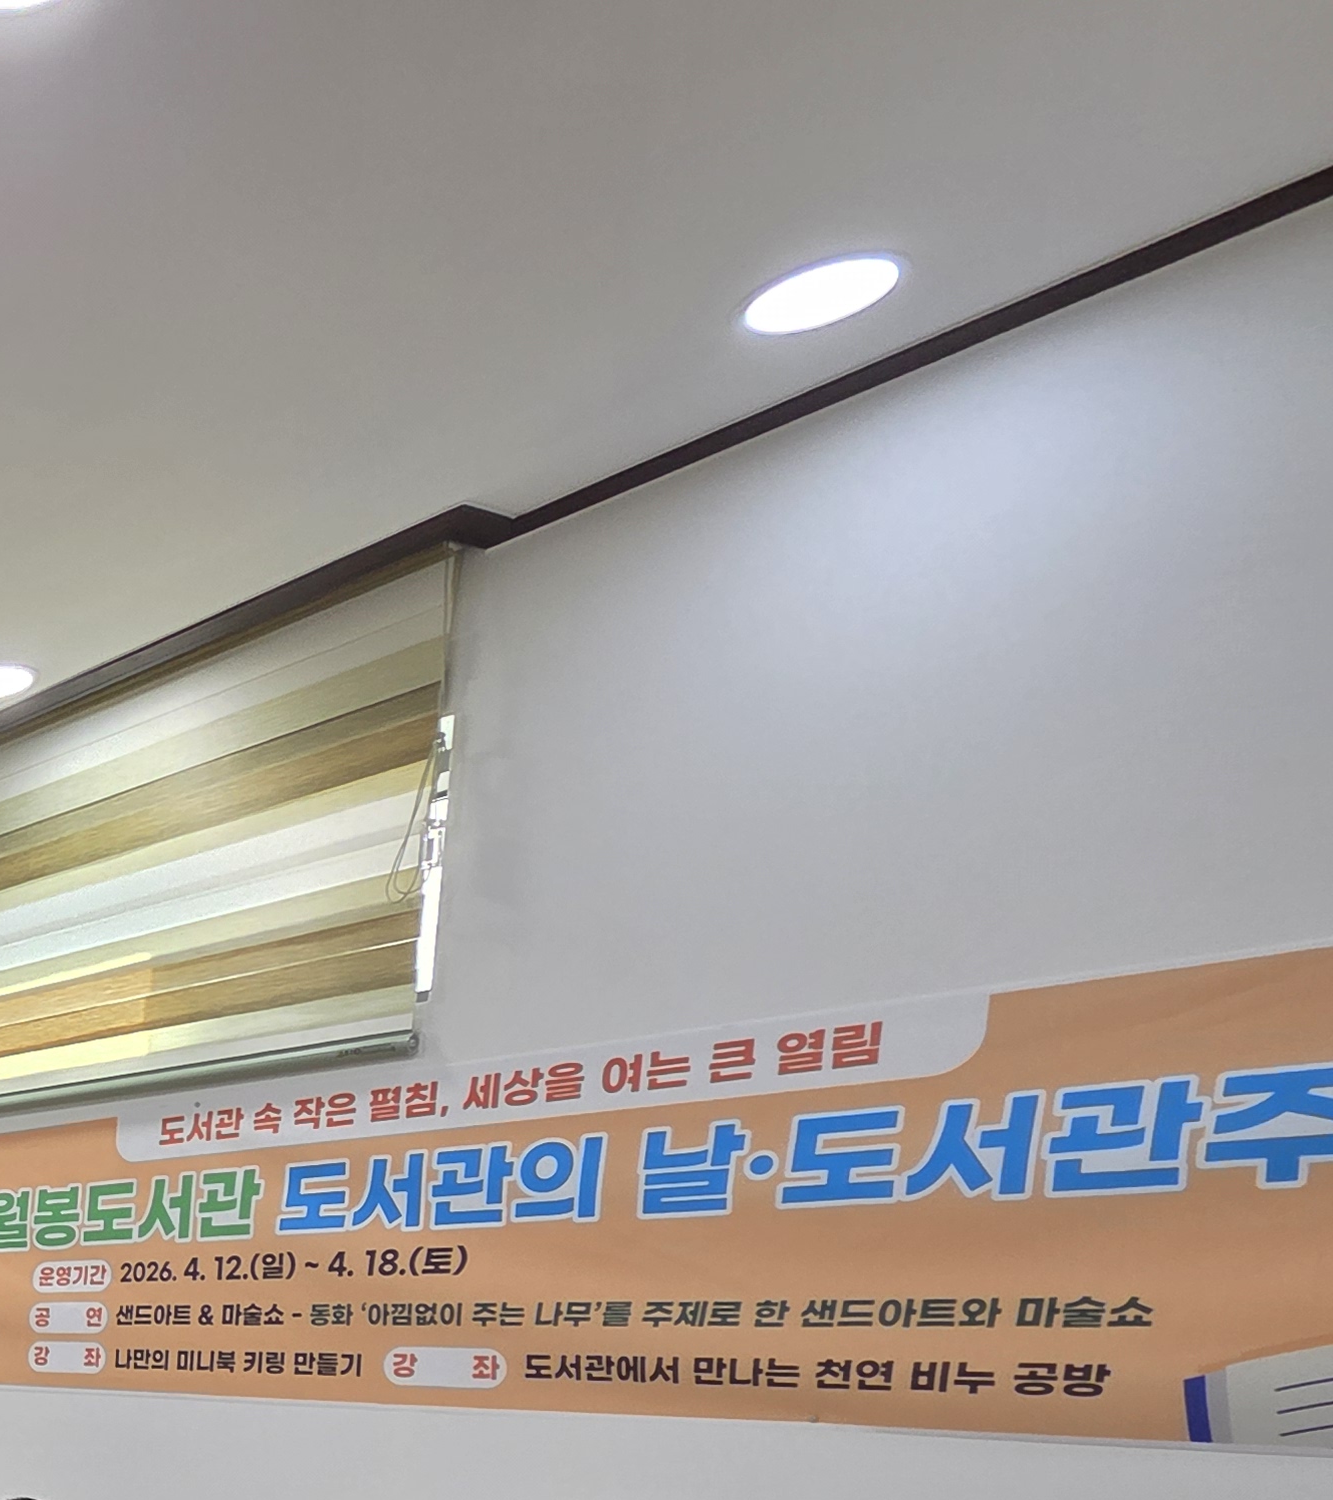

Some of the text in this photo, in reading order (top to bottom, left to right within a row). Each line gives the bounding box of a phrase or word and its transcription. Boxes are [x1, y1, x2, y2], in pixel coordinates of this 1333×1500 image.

[159, 1020, 883, 1146] 도서관 속 작은 펼침, 세상을 여는 큰 열림
[278, 1134, 606, 1230] 도서관의
[38, 1267, 107, 1287] 운영기간
[119, 1261, 177, 1283] 2026.
[183, 1256, 205, 1281] 4.
[215, 1251, 297, 1281] 12.(일)
[327, 1250, 353, 1277] 4.
[365, 1245, 469, 1277] 18.(토)
[115, 1305, 192, 1326] 샌드아트
[197, 1305, 213, 1326] &
[221, 1303, 284, 1327] 마술쇼
[309, 1303, 353, 1327] 동화
[471, 1302, 525, 1327] 주는
[641, 1301, 742, 1328] 주제로
[754, 1299, 790, 1328] 한
[800, 1297, 1002, 1328] 샌드아트와
[1015, 1296, 1154, 1329] 마술쇼
[114, 1348, 169, 1371] 나만의
[177, 1349, 236, 1373] 미니북
[243, 1351, 286, 1374] 키링
[293, 1353, 362, 1377] 만들기
[524, 1353, 680, 1384] 도서관에서
[693, 1356, 800, 1388] 만나는
[815, 1358, 894, 1391] 천연
[910, 1360, 996, 1394] 비누
[1013, 1362, 1112, 1397] 공방
